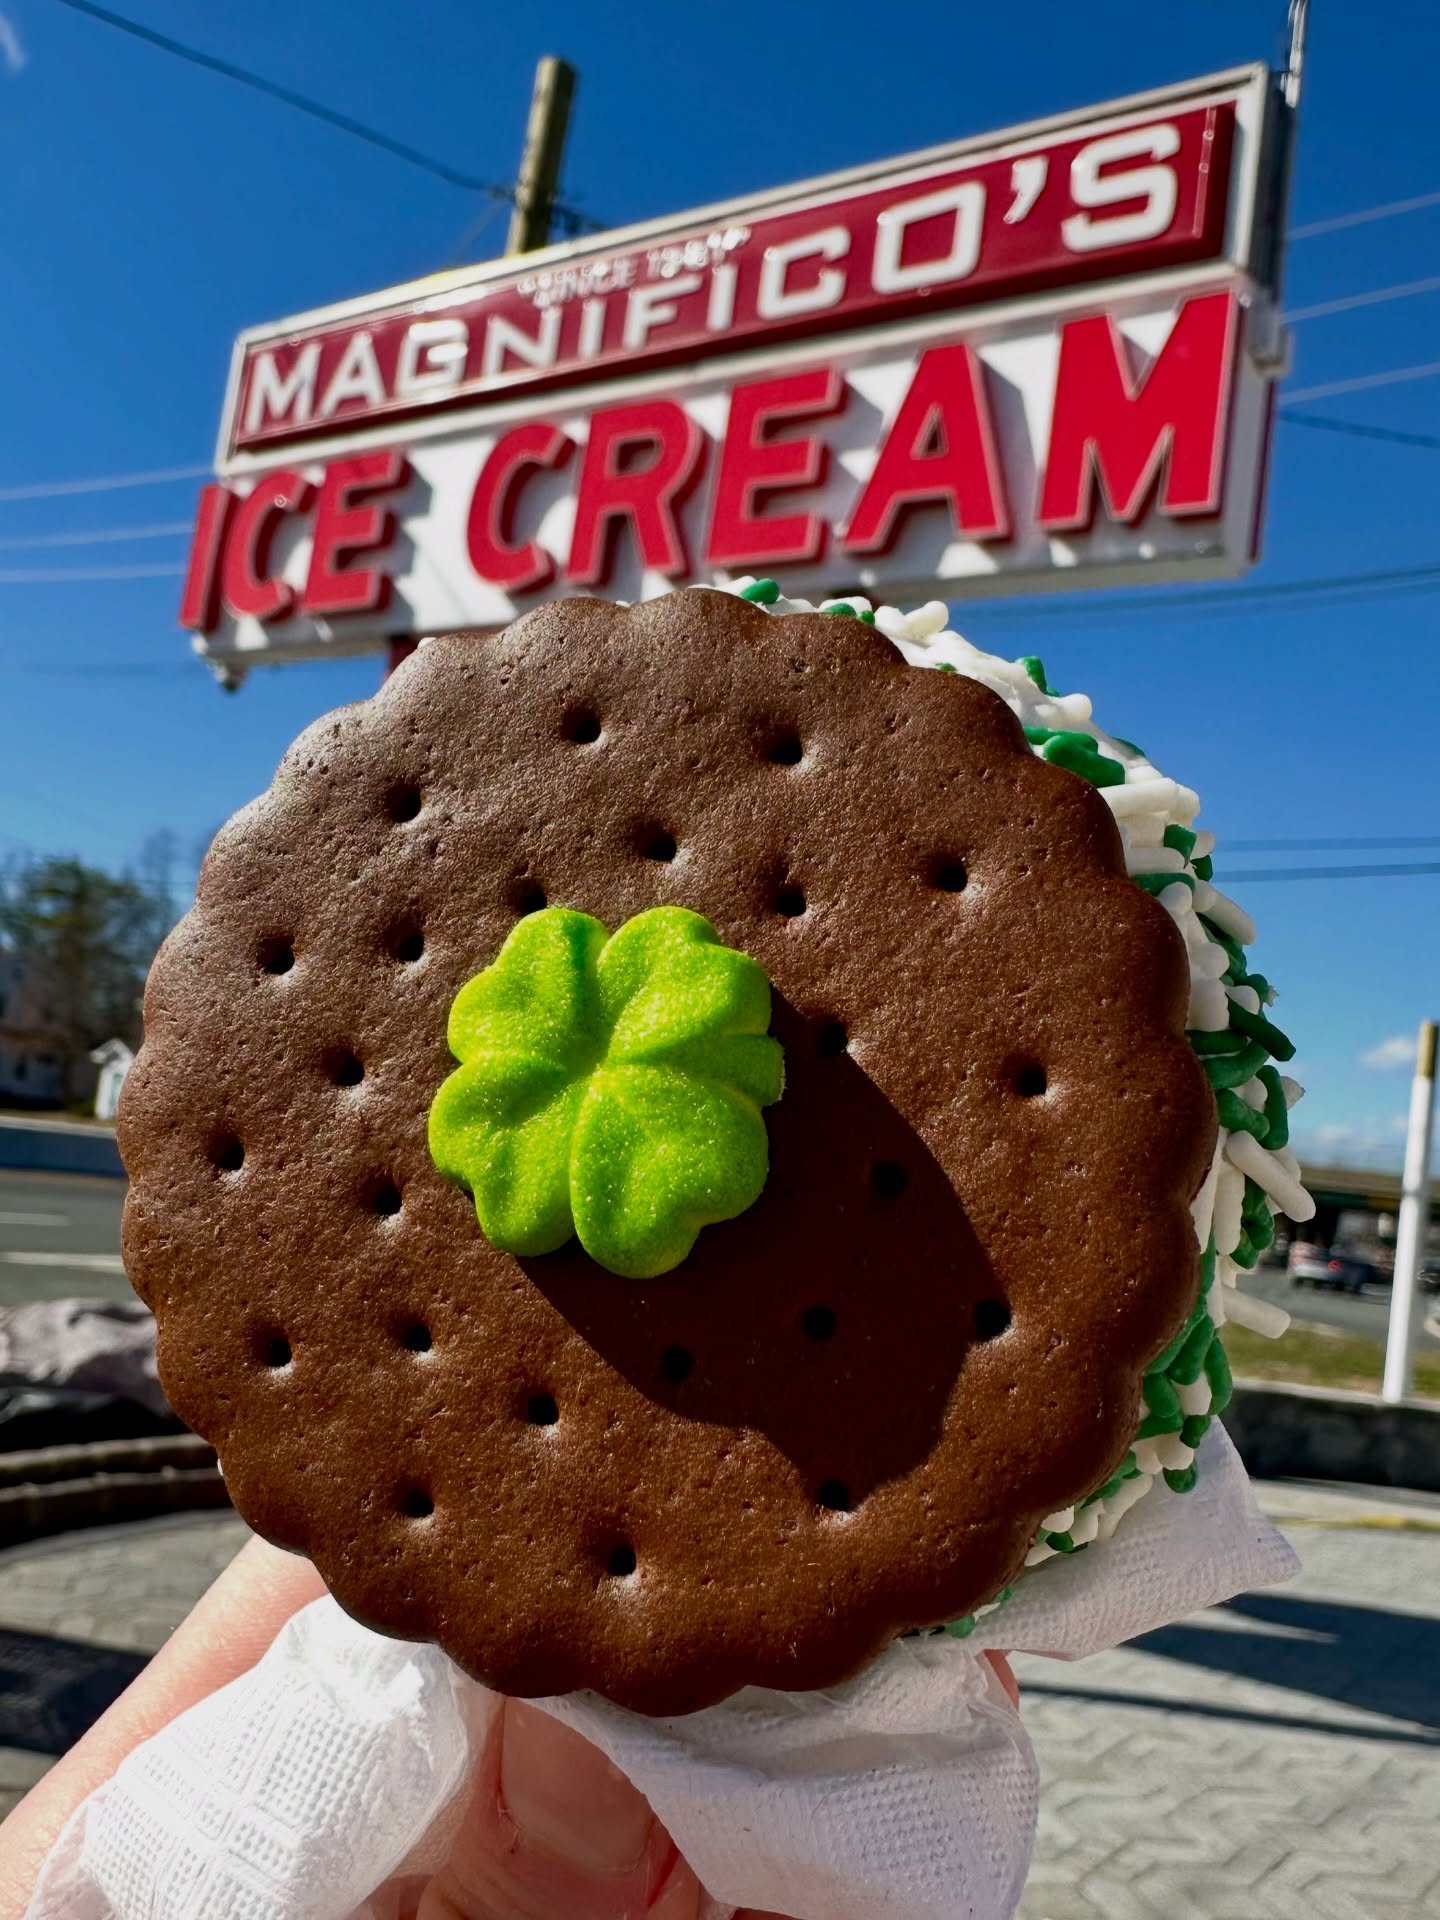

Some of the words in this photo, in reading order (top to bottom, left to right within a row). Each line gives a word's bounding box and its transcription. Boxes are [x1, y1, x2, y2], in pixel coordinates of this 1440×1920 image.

[243, 122, 1182, 434] MAGNIFICO'S
[178, 449, 409, 634] ICE
[466, 290, 1238, 594] CREAM
